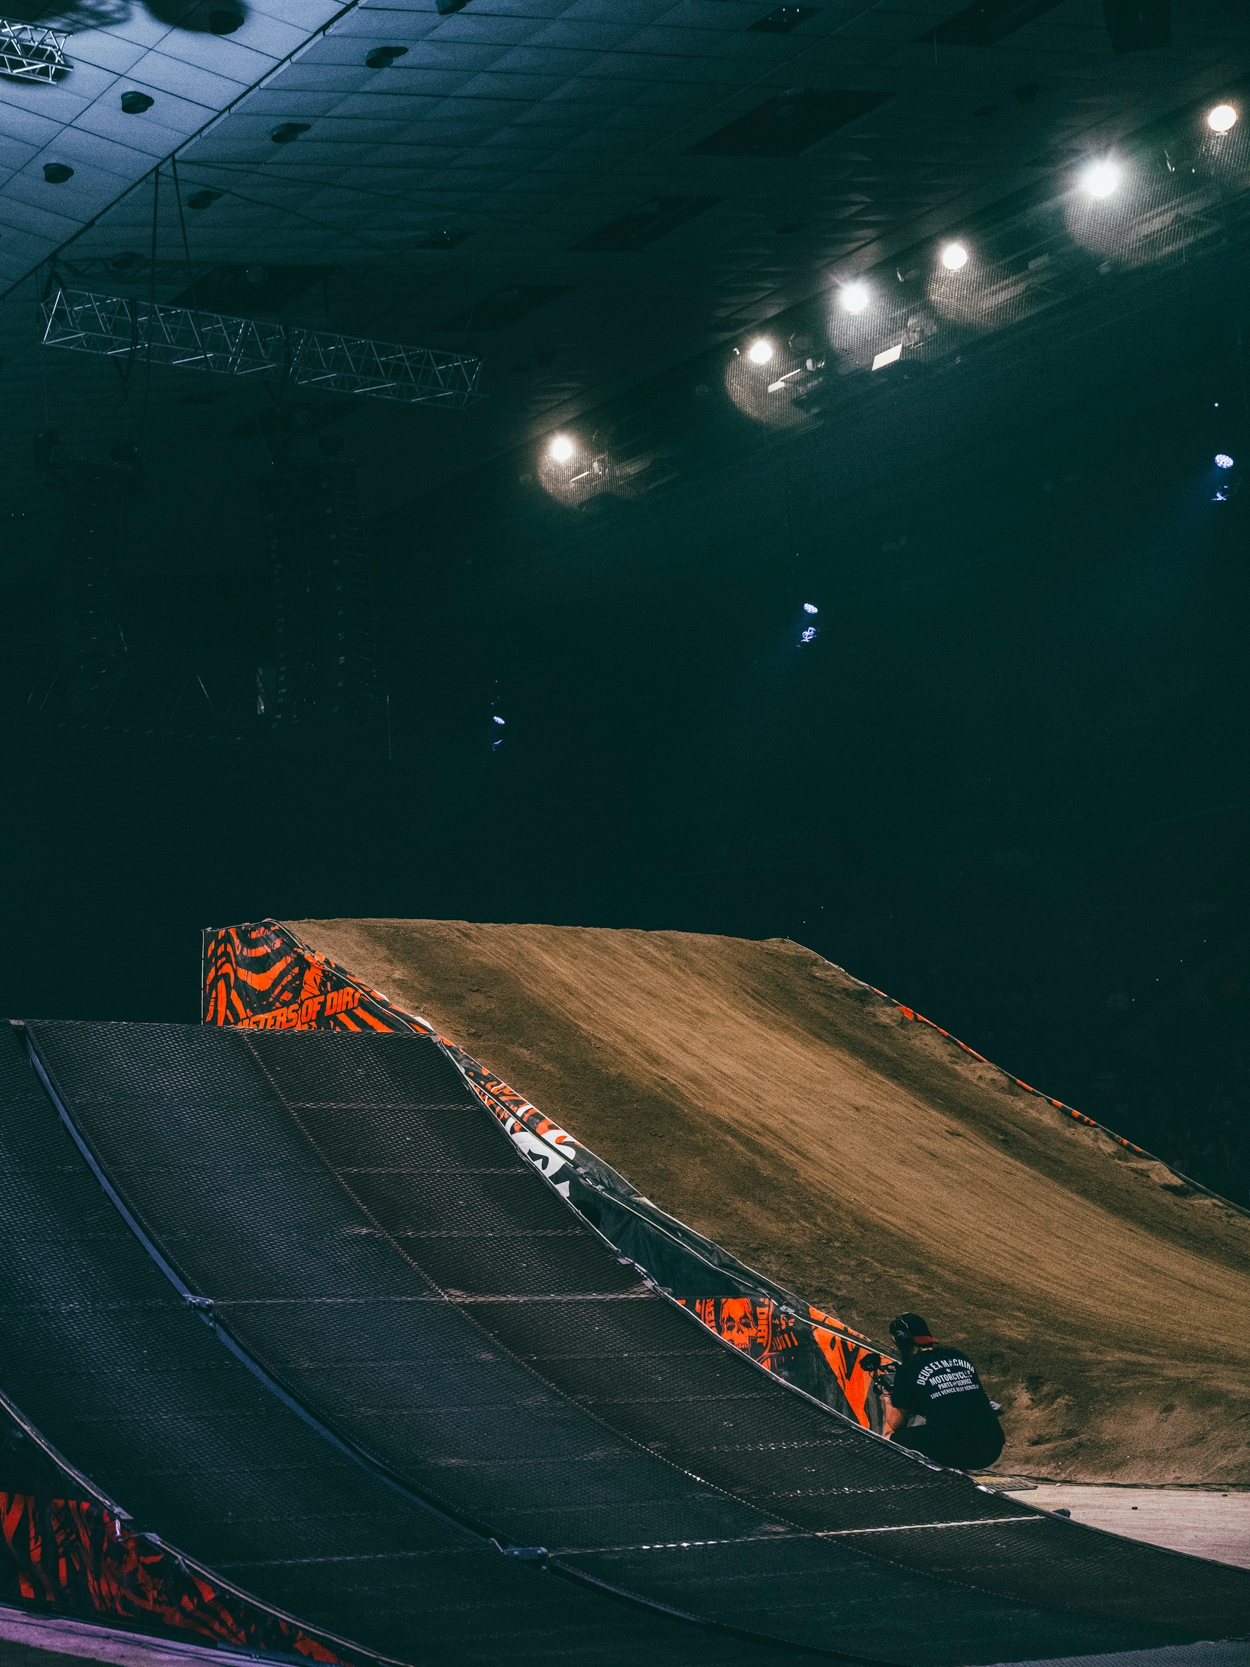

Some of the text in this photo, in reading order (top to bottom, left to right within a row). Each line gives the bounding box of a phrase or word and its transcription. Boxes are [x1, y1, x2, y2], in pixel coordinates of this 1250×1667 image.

[301, 997, 325, 1022] OF
[917, 1359, 974, 1385] DEUS EX MACHINA
[938, 1382, 953, 1390] PARTS
